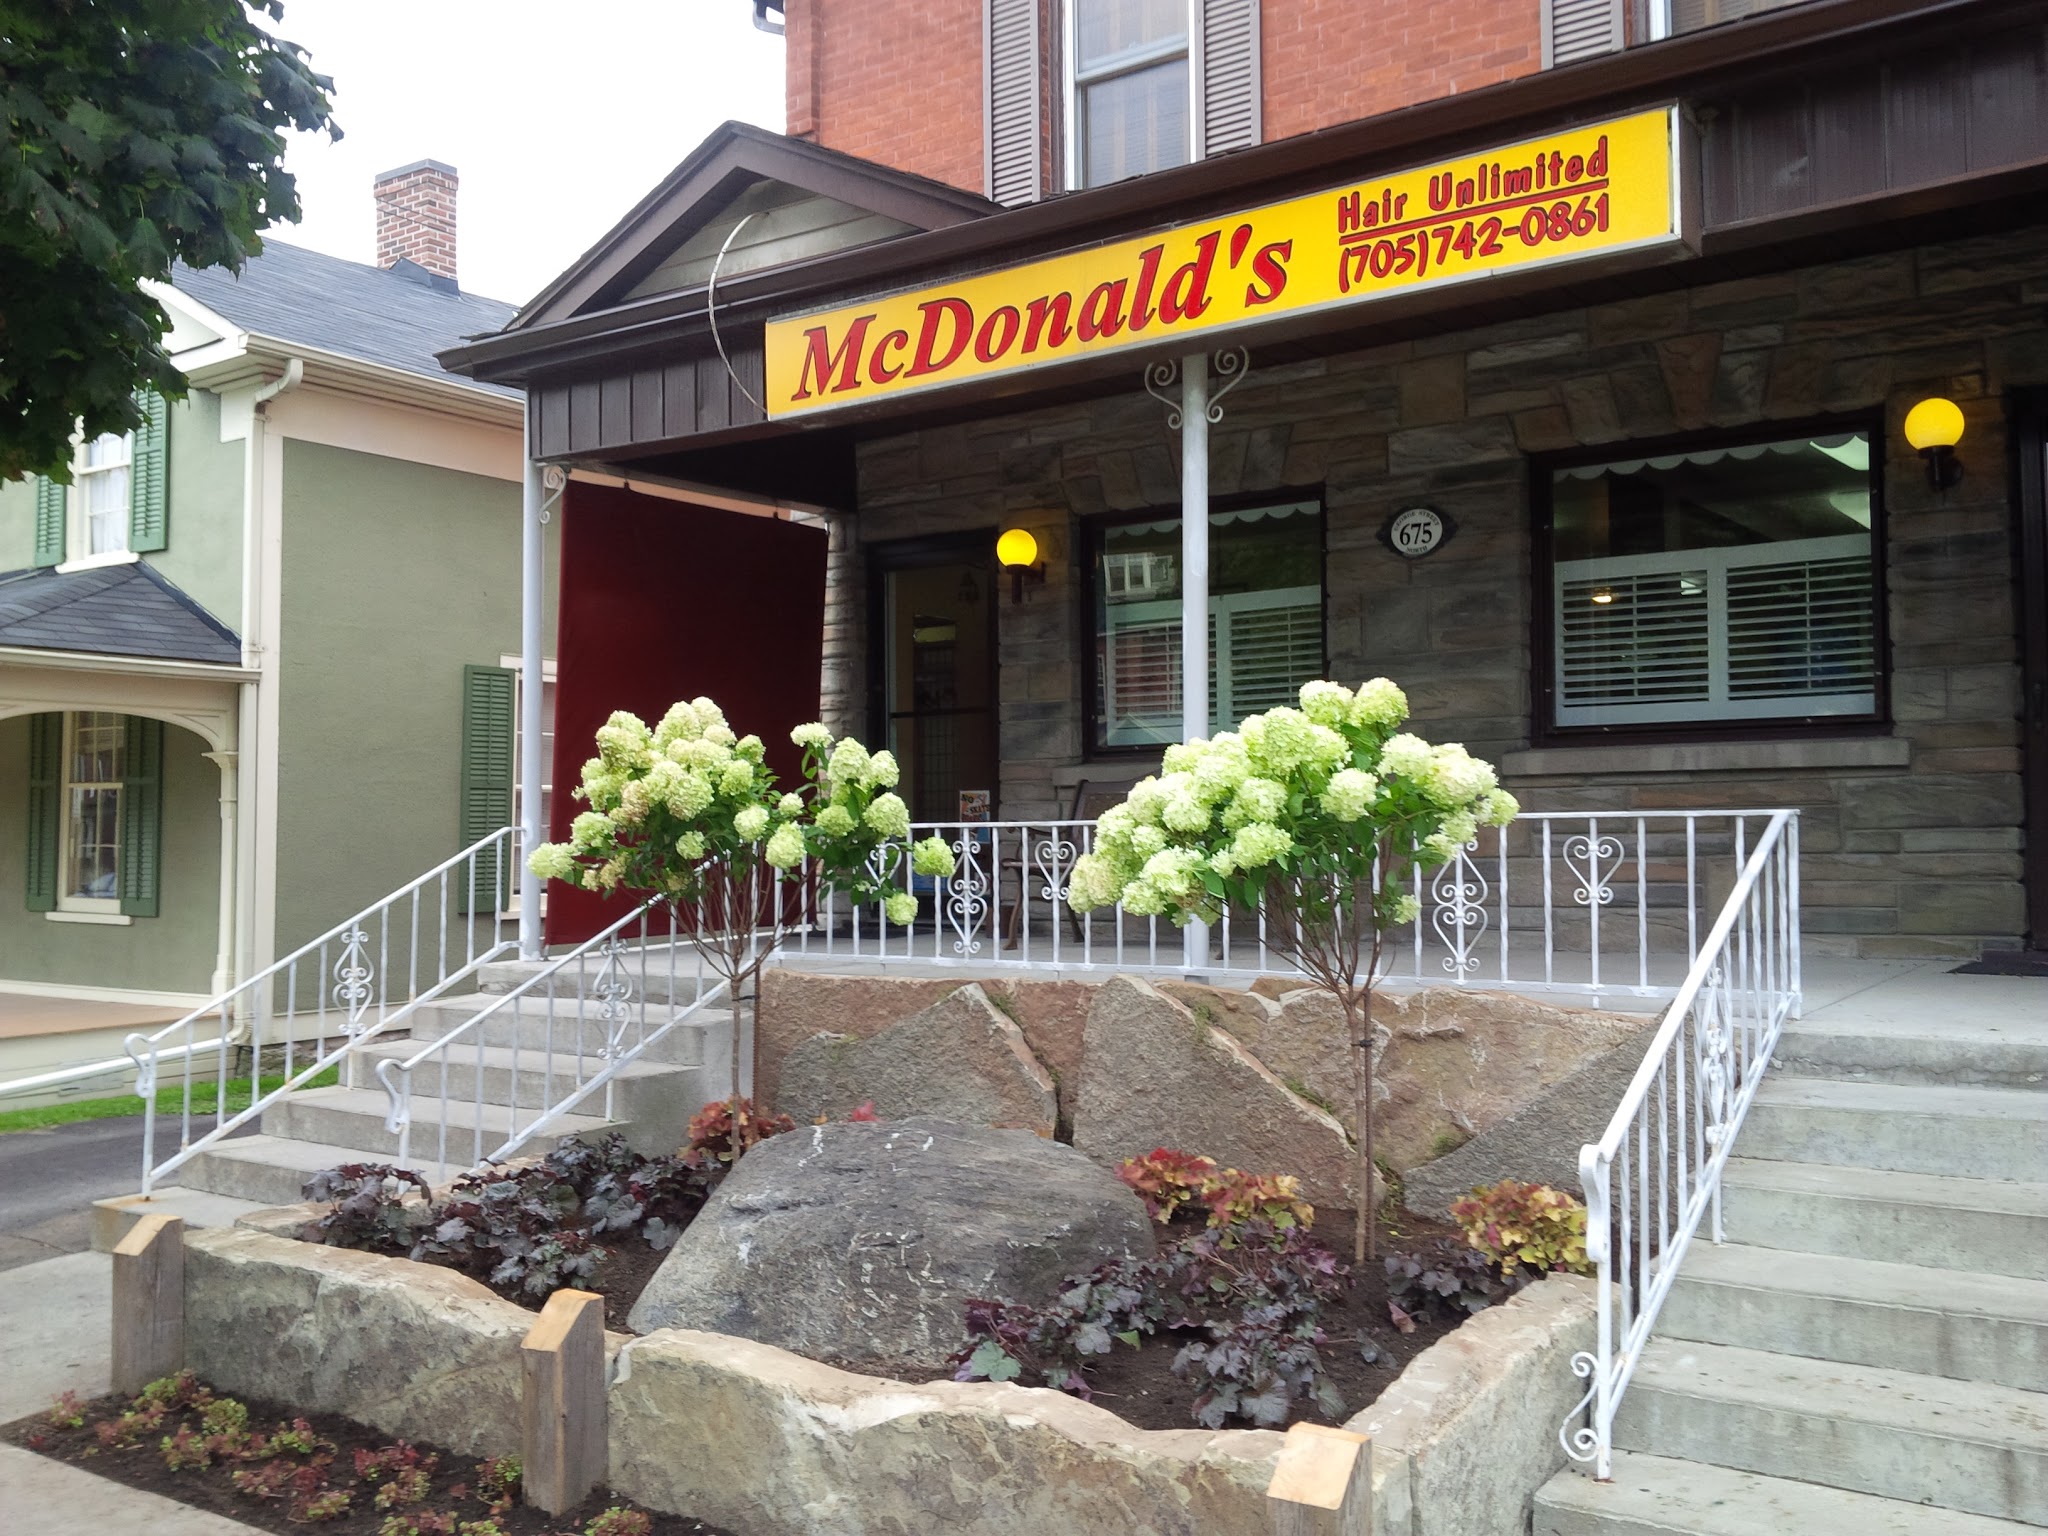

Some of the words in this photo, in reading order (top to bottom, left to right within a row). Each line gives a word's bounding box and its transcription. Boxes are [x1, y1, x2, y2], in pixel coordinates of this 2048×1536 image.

[1338, 189, 1408, 233] Hair
[1428, 135, 1608, 211] Unlimited
[1338, 193, 1610, 293] (705)742-0861
[791, 224, 1294, 401] McDonald's
[1400, 521, 1433, 546] 675
[1419, 511, 1440, 526] STREET
